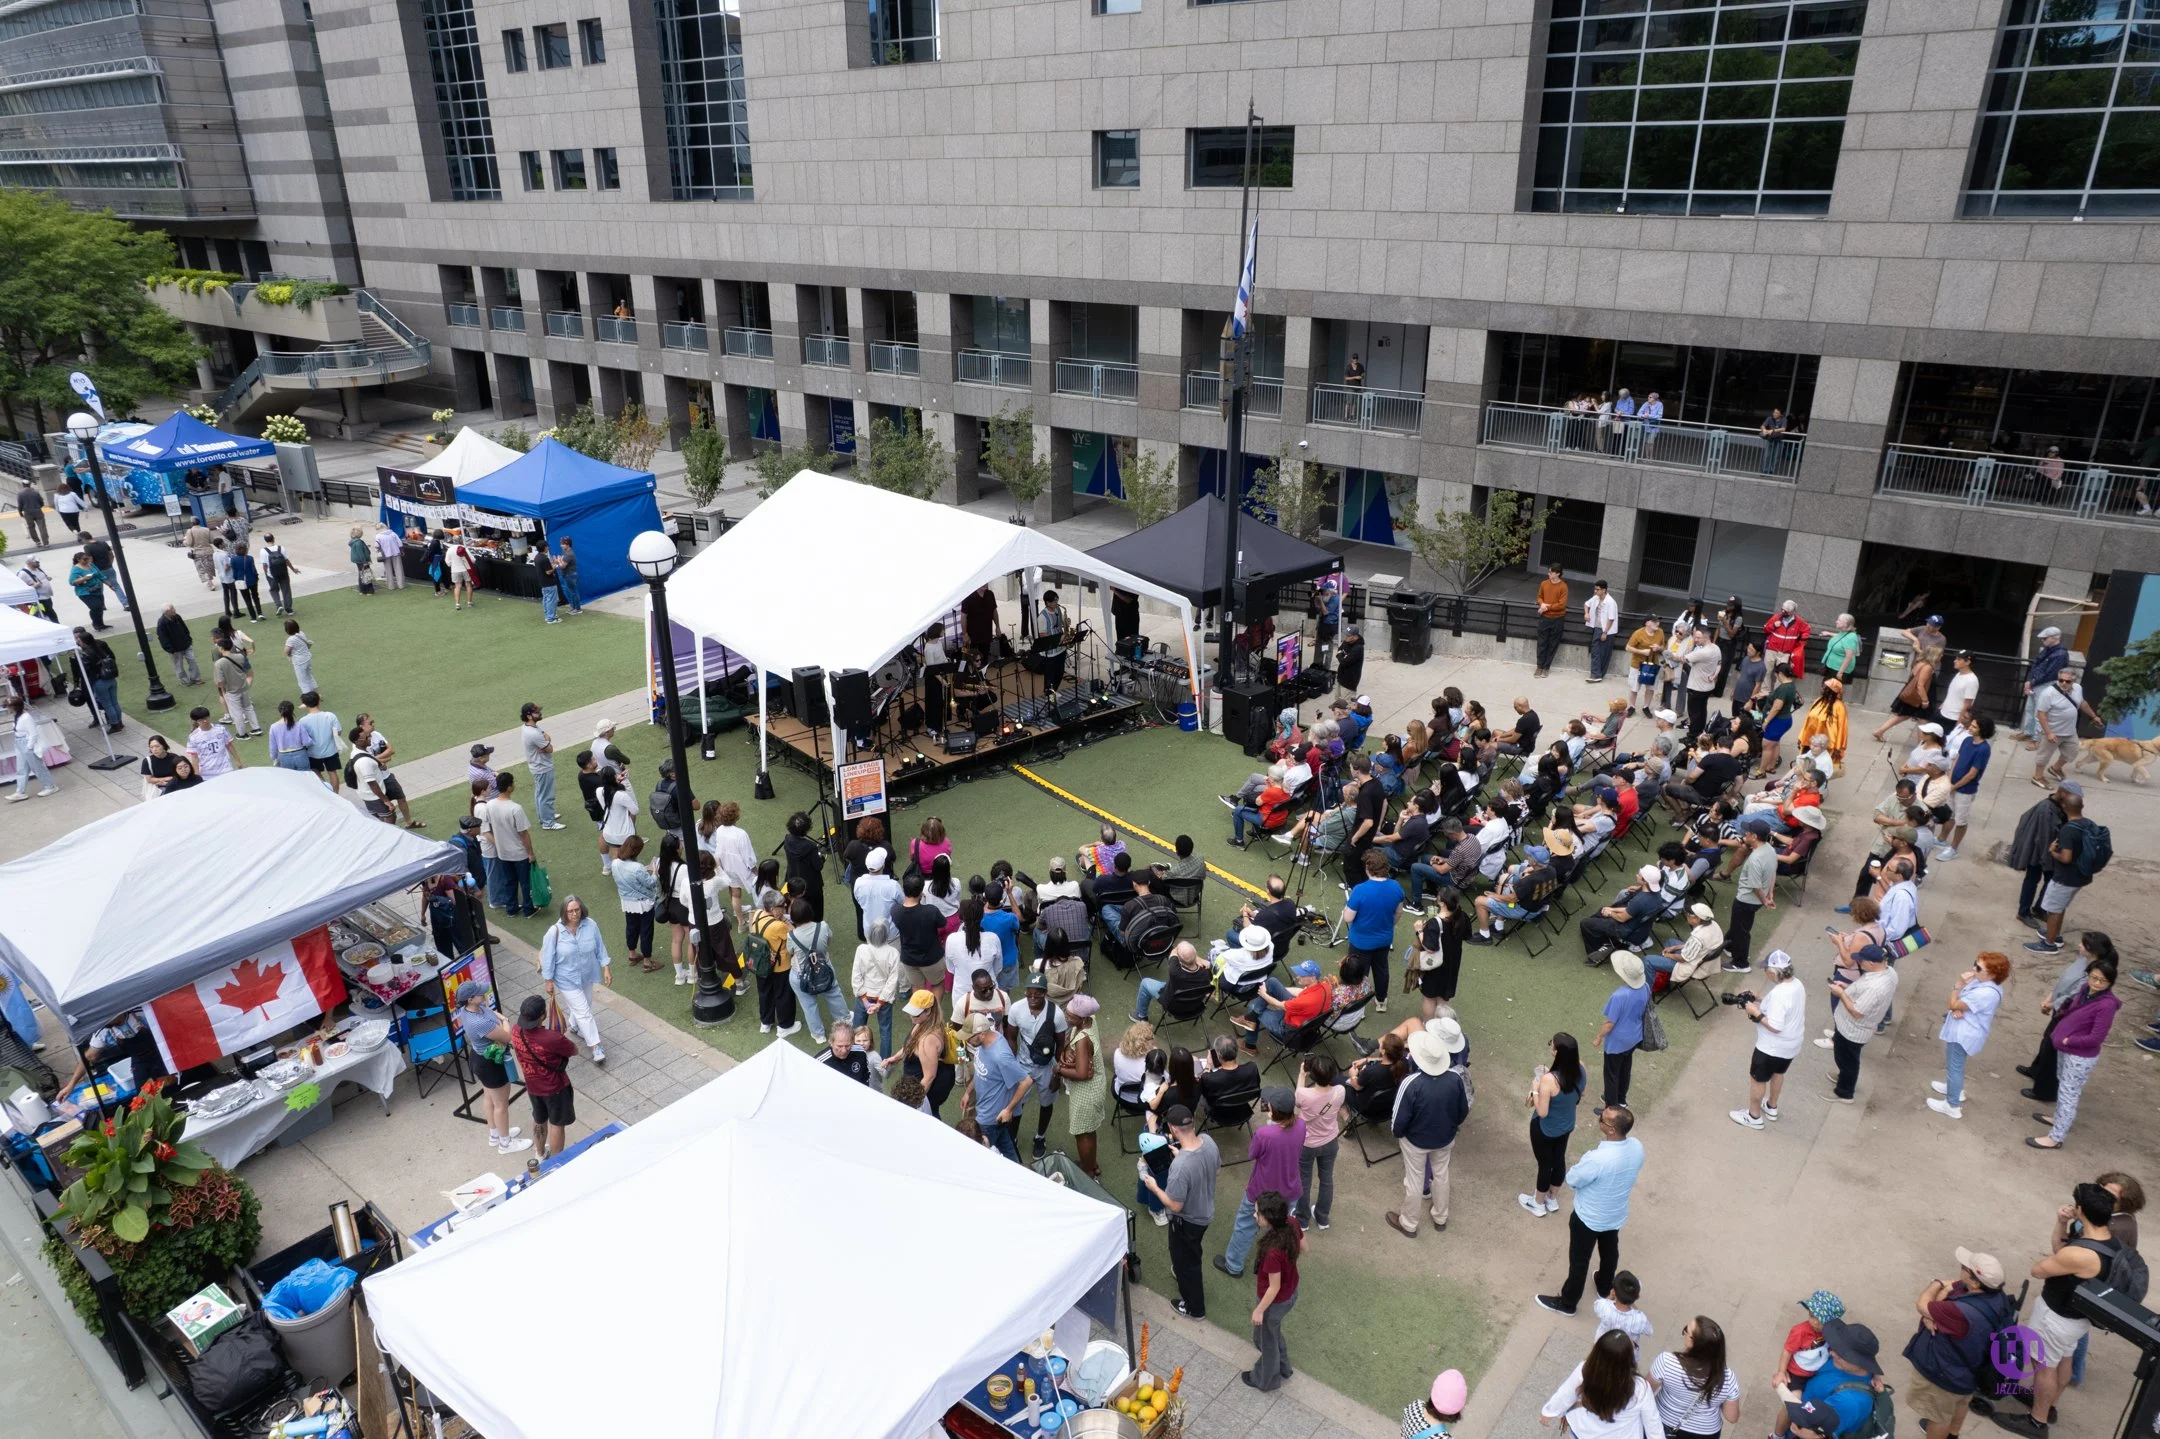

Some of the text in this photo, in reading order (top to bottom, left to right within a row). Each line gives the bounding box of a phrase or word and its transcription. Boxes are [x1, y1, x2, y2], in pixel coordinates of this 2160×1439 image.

[174, 448, 261, 467] www.toronto.ca/water
[843, 761, 880, 773] LDM STAGE
[843, 769, 867, 778] LINEUP
